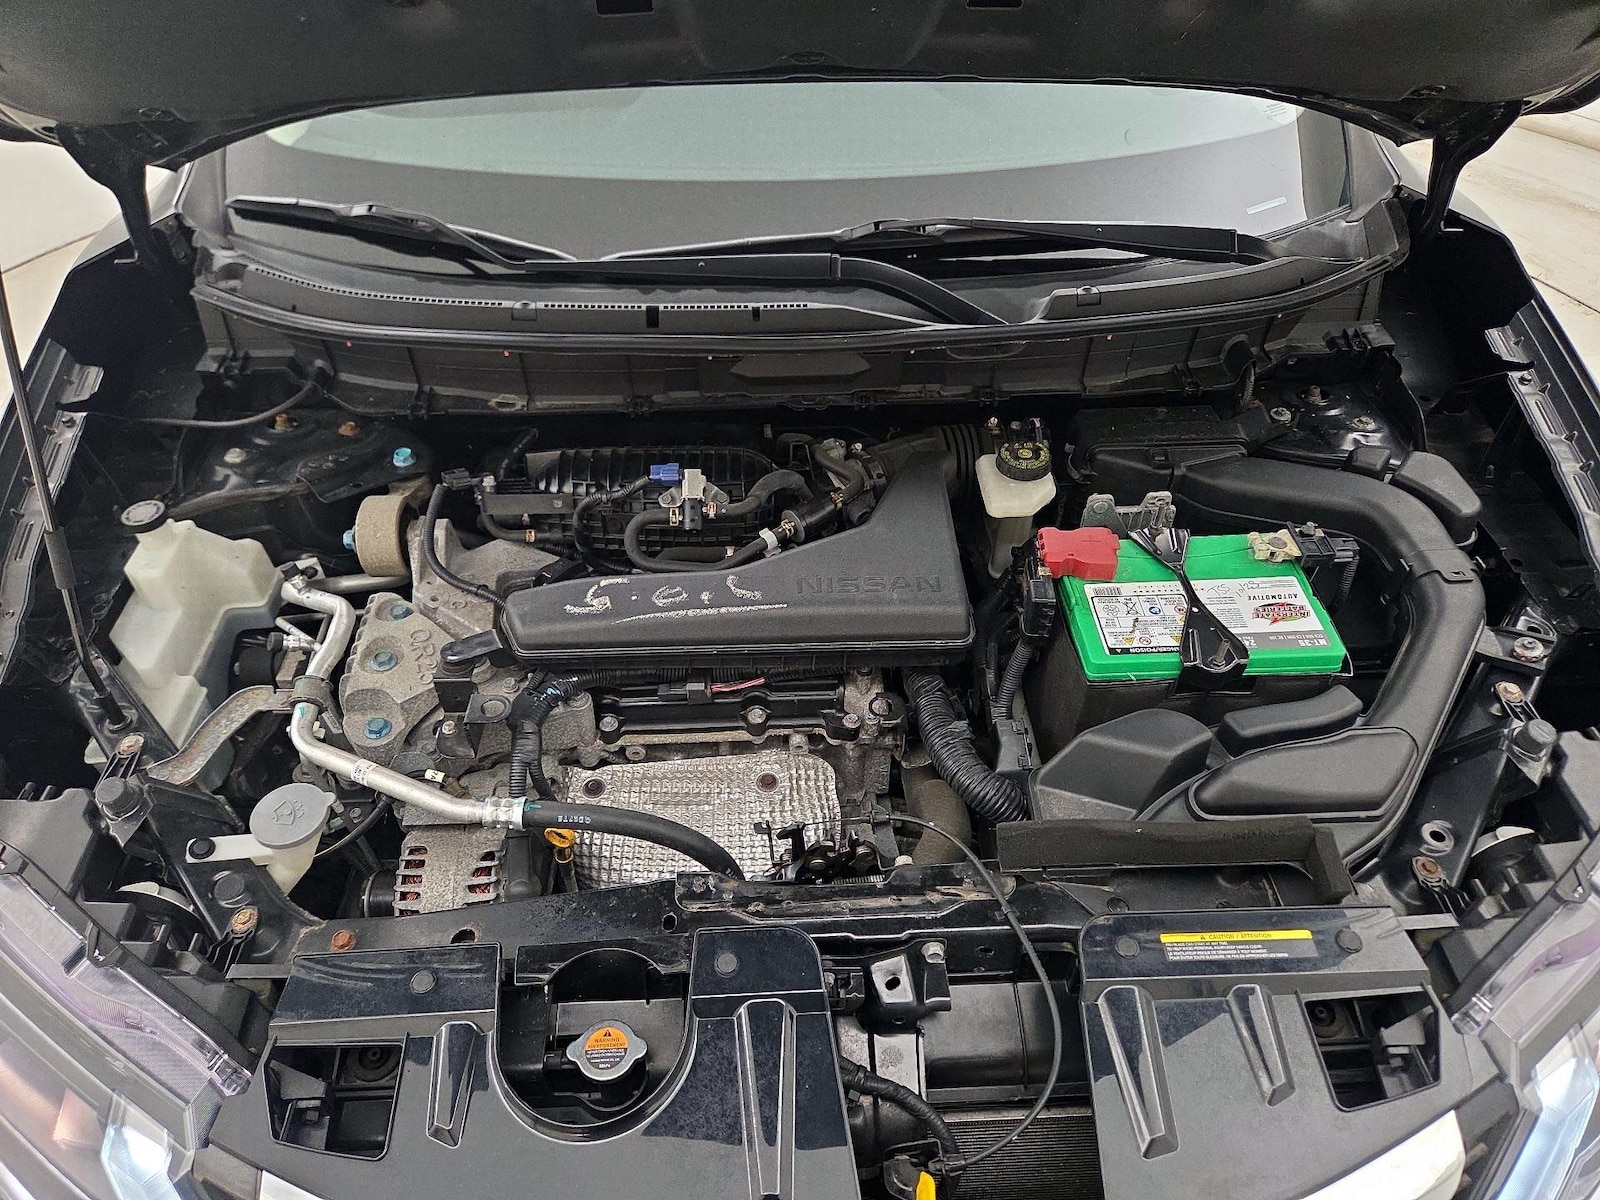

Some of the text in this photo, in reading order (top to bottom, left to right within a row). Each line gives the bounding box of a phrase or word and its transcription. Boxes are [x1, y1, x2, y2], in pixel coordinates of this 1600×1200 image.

[796, 574, 942, 595] NISSAN
[1247, 593, 1299, 602] AUTOMOTIVE
[1129, 646, 1180, 654] ANGER/POISON
